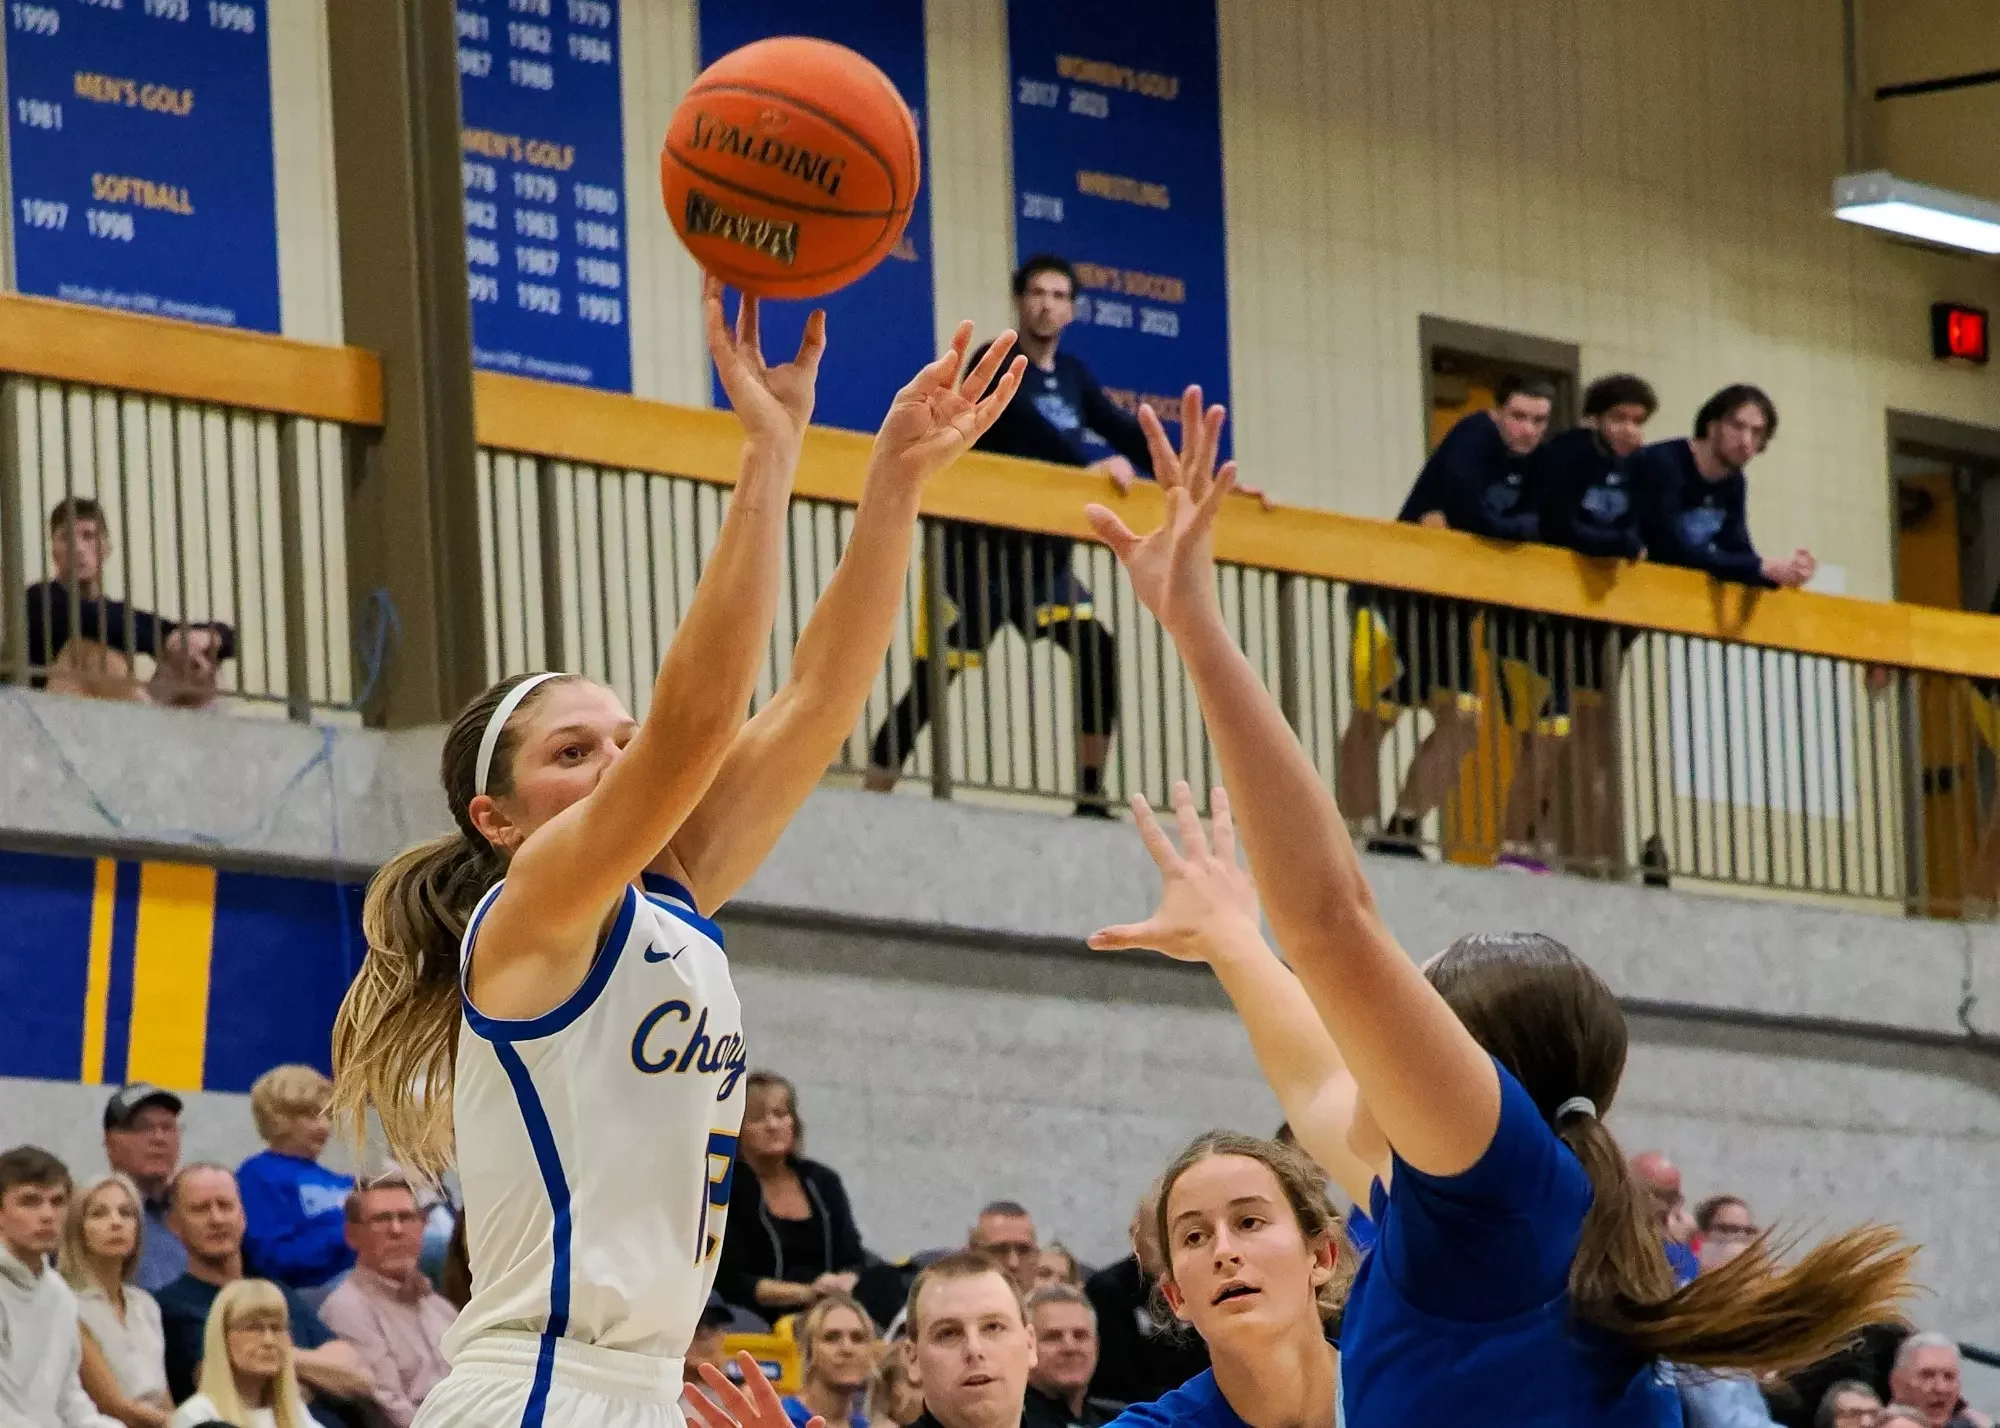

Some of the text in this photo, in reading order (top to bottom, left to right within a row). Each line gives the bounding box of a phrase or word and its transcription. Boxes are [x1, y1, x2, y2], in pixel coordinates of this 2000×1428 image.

[457, 11, 488, 41] 981
[140, 83, 193, 115] GOLF
[1137, 72, 1179, 100] GOLF
[19, 99, 62, 131] 1981
[525, 141, 575, 171] GOLF
[690, 111, 847, 198] SPALDING
[92, 173, 194, 214] SOFTBALL
[22, 199, 67, 229] 1997
